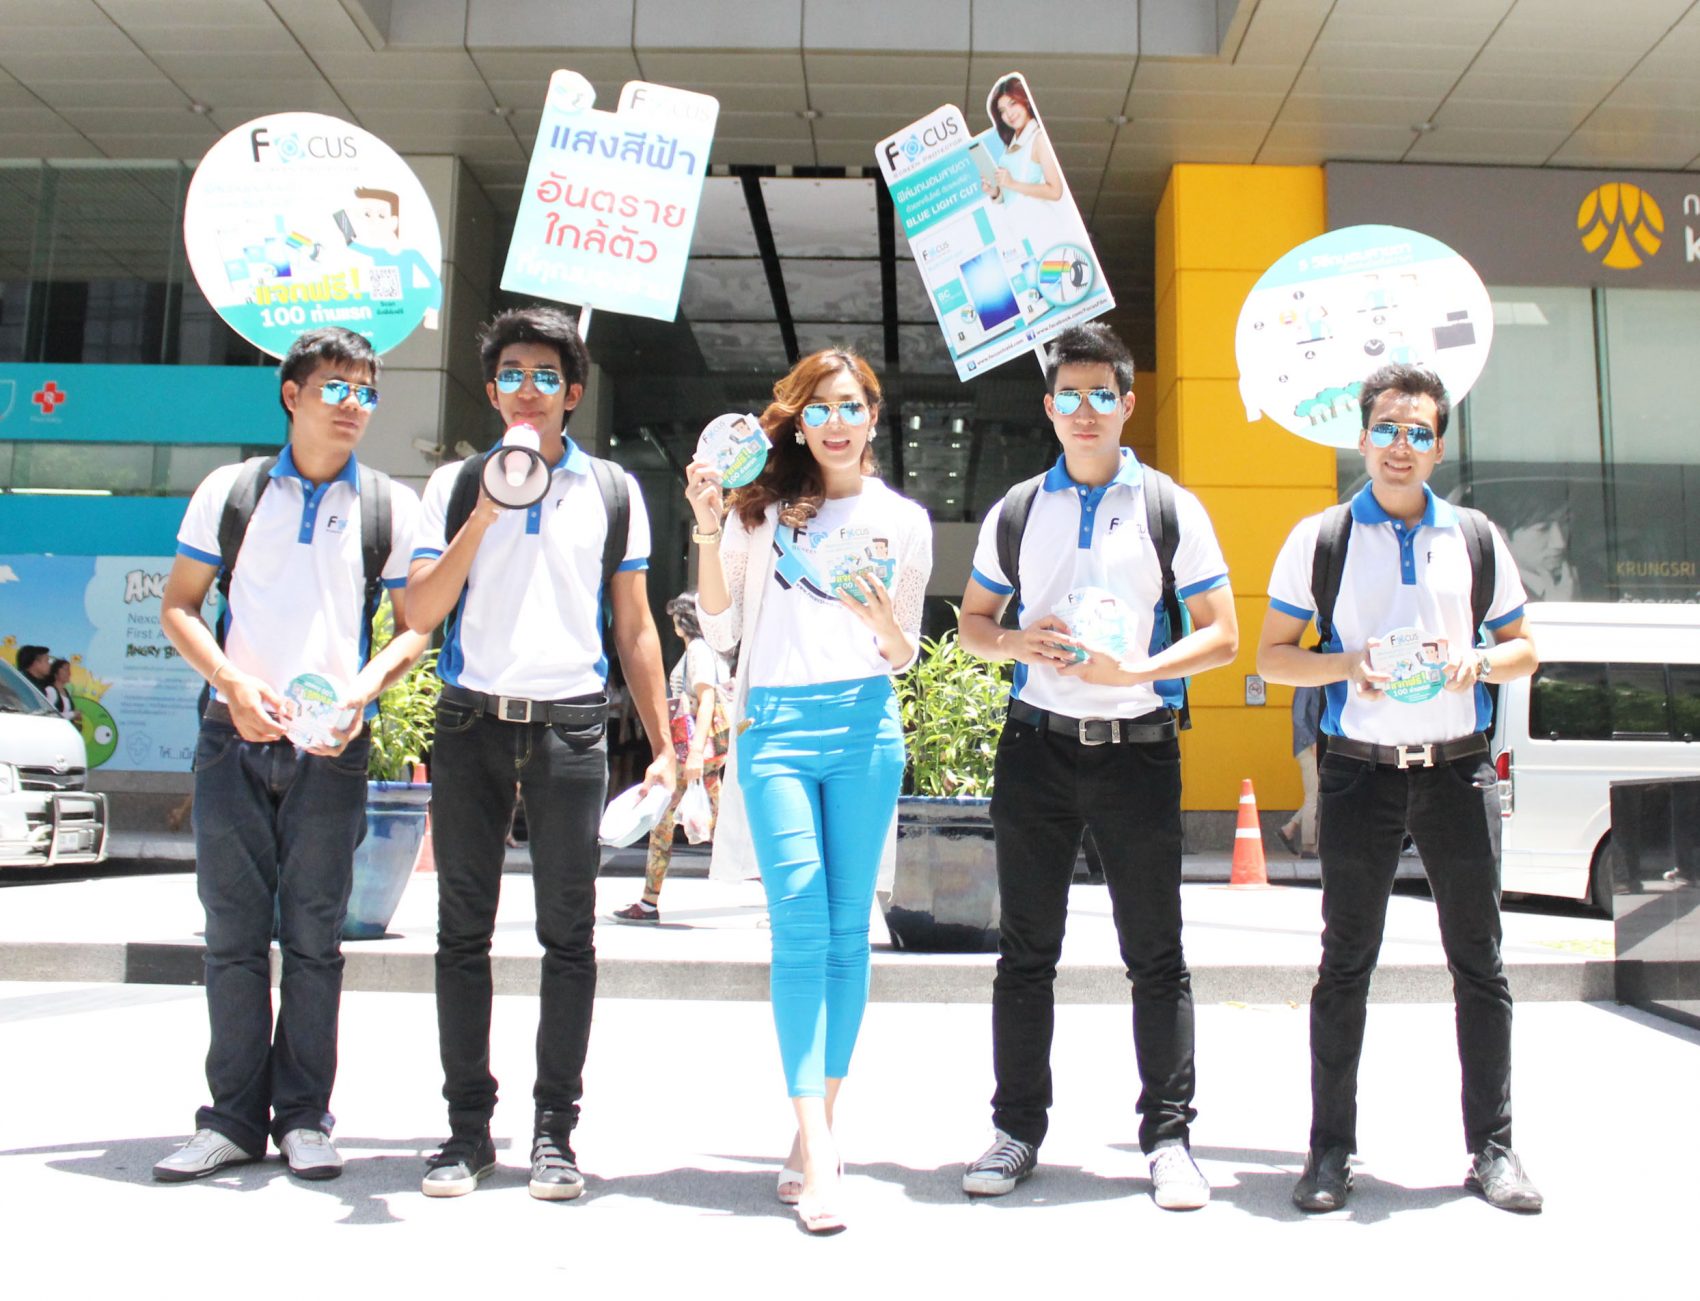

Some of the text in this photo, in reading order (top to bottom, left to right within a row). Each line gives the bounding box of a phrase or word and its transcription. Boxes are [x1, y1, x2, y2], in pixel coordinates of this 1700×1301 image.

[251, 128, 358, 162] FOCUS
[550, 125, 696, 176] แสงสีฟ้า
[885, 117, 959, 171] FOCUS
[536, 171, 686, 228] อันตราย
[906, 208, 931, 228] BLUE
[931, 193, 961, 214] LIGHT
[960, 182, 979, 199] CUT
[544, 211, 658, 263] ใกล้ตัว
[260, 303, 373, 327] 100 ท่านแรก
[1616, 561, 1696, 577] KRUNGSRI
[126, 643, 160, 658] ANGRY
[127, 627, 153, 639] First
